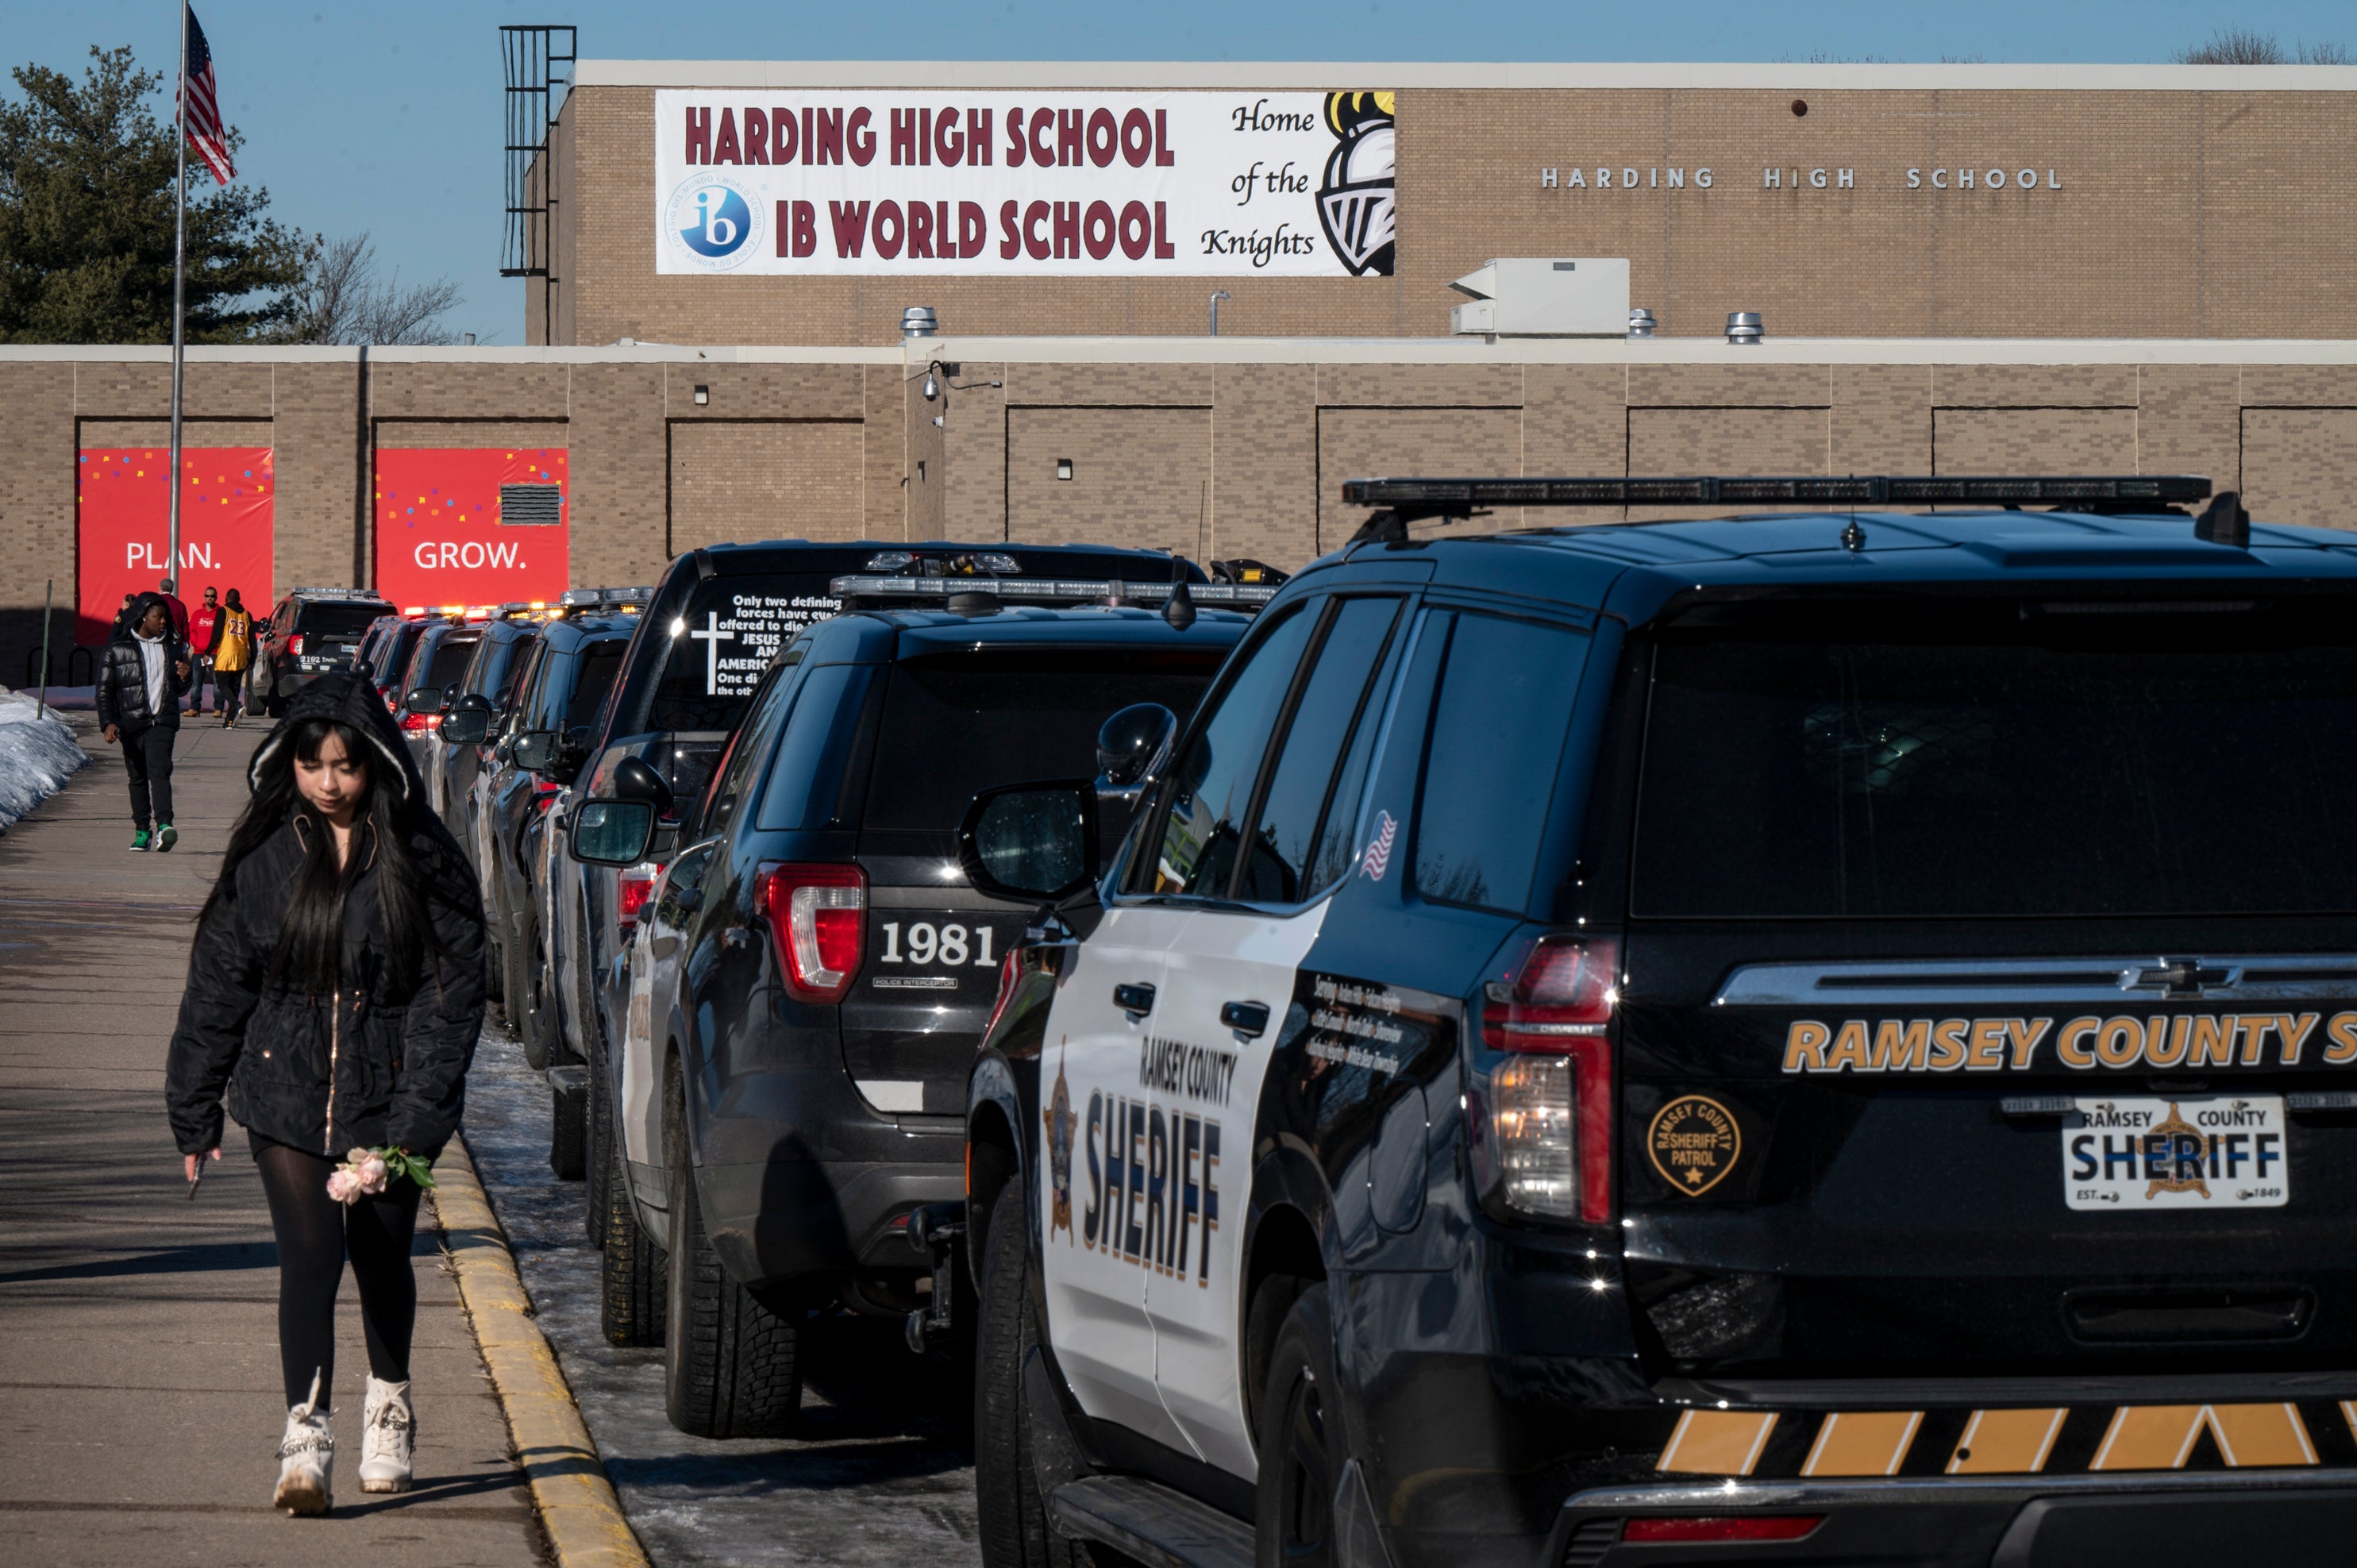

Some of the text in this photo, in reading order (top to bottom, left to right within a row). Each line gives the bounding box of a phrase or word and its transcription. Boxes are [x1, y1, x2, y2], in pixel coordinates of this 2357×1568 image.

[1231, 98, 1315, 132] Home
[685, 106, 1175, 168] HARDING HIGH SCHOOL
[683, 175, 714, 194] MUNDO
[1231, 161, 1308, 206] of the
[1541, 167, 2062, 189] HARDING HIGH SCHOOL
[722, 177, 761, 229] WORLD SCHOOL
[776, 199, 1175, 260] IB WORLD SCHOOL
[1201, 222, 1315, 268] Knights
[685, 251, 717, 268] MONDE
[414, 541, 526, 569] GROW.
[733, 595, 842, 611] Only two defining
[736, 607, 775, 618] forces
[778, 607, 808, 619] have
[229, 618, 245, 637] 23
[718, 619, 764, 632] offered
[768, 621, 780, 631] to
[741, 634, 780, 645] JESUS
[300, 655, 321, 664] 2192
[755, 645, 778, 657] AN
[717, 658, 769, 670] AMERIC
[717, 672, 742, 684] One
[717, 686, 734, 695] the
[881, 922, 997, 967] 1981
[903, 978, 955, 987] INTERCEPTOR
[1314, 974, 1338, 1006] Serving
[1540, 1024, 1593, 1033] CHEVROLET
[1781, 1018, 2053, 1073] RAMSEY
[2056, 1012, 2321, 1069] COUNTY
[1140, 1034, 1238, 1108] RAMSEY COUNTY
[1657, 1104, 1732, 1150] RAMSEY COUNTY
[2082, 1110, 2266, 1127] RAMSEY COUNTY
[1670, 1132, 1718, 1149] SHERIFF
[1671, 1150, 1716, 1166] PATROL
[2070, 1133, 2280, 1181] SHERIFF
[1083, 1087, 1221, 1289] SHERIFF
[2076, 1188, 2282, 1200] EST. 1849
